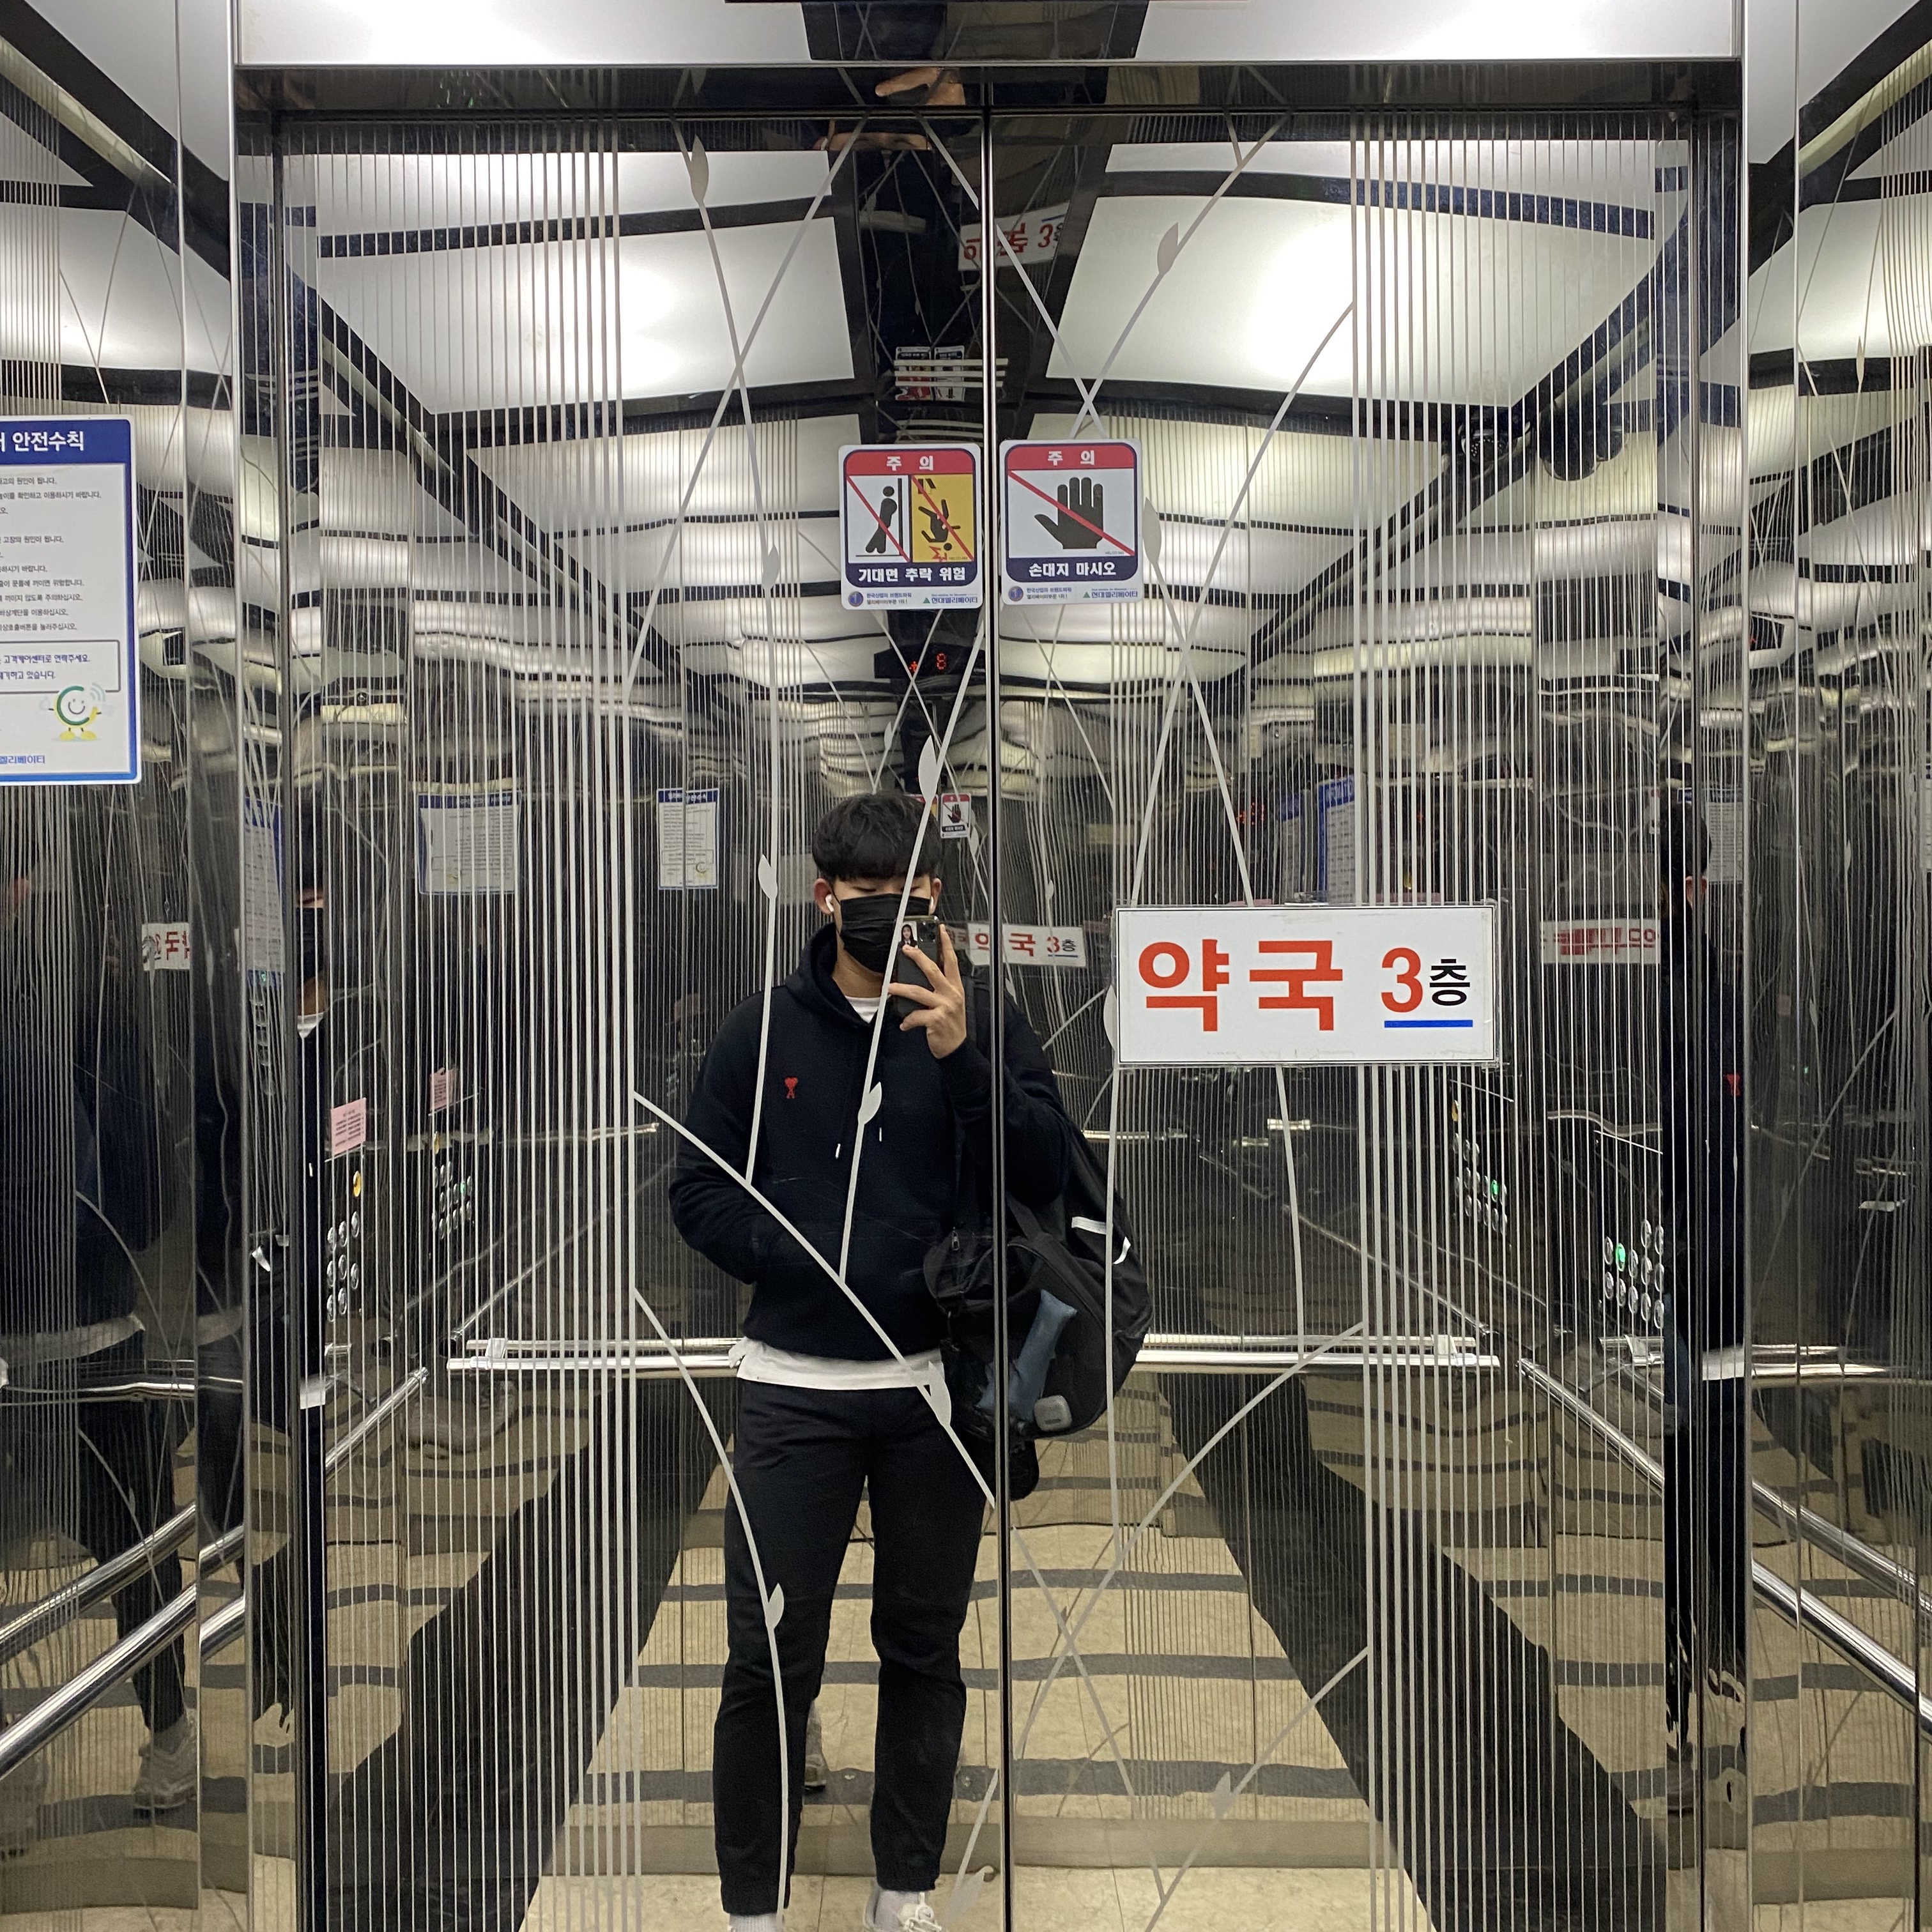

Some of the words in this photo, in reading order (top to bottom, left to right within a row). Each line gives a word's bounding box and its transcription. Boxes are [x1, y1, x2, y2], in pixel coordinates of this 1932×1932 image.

[12, 431, 84, 452] 안전수칙
[17, 477, 34, 485] 원인이
[37, 477, 57, 485] 됩니다.
[75, 491, 102, 499] 바랍니다.
[858, 567, 898, 582] 기대면
[905, 567, 933, 582] 추락
[939, 567, 966, 581] 위험
[1029, 563, 1070, 577] 손대지
[1076, 562, 1117, 576] 마시오
[4, 654, 51, 664] 고객케어센터로
[26, 671, 56, 680] 있습니다.
[1381, 947, 1471, 1013] 3층
